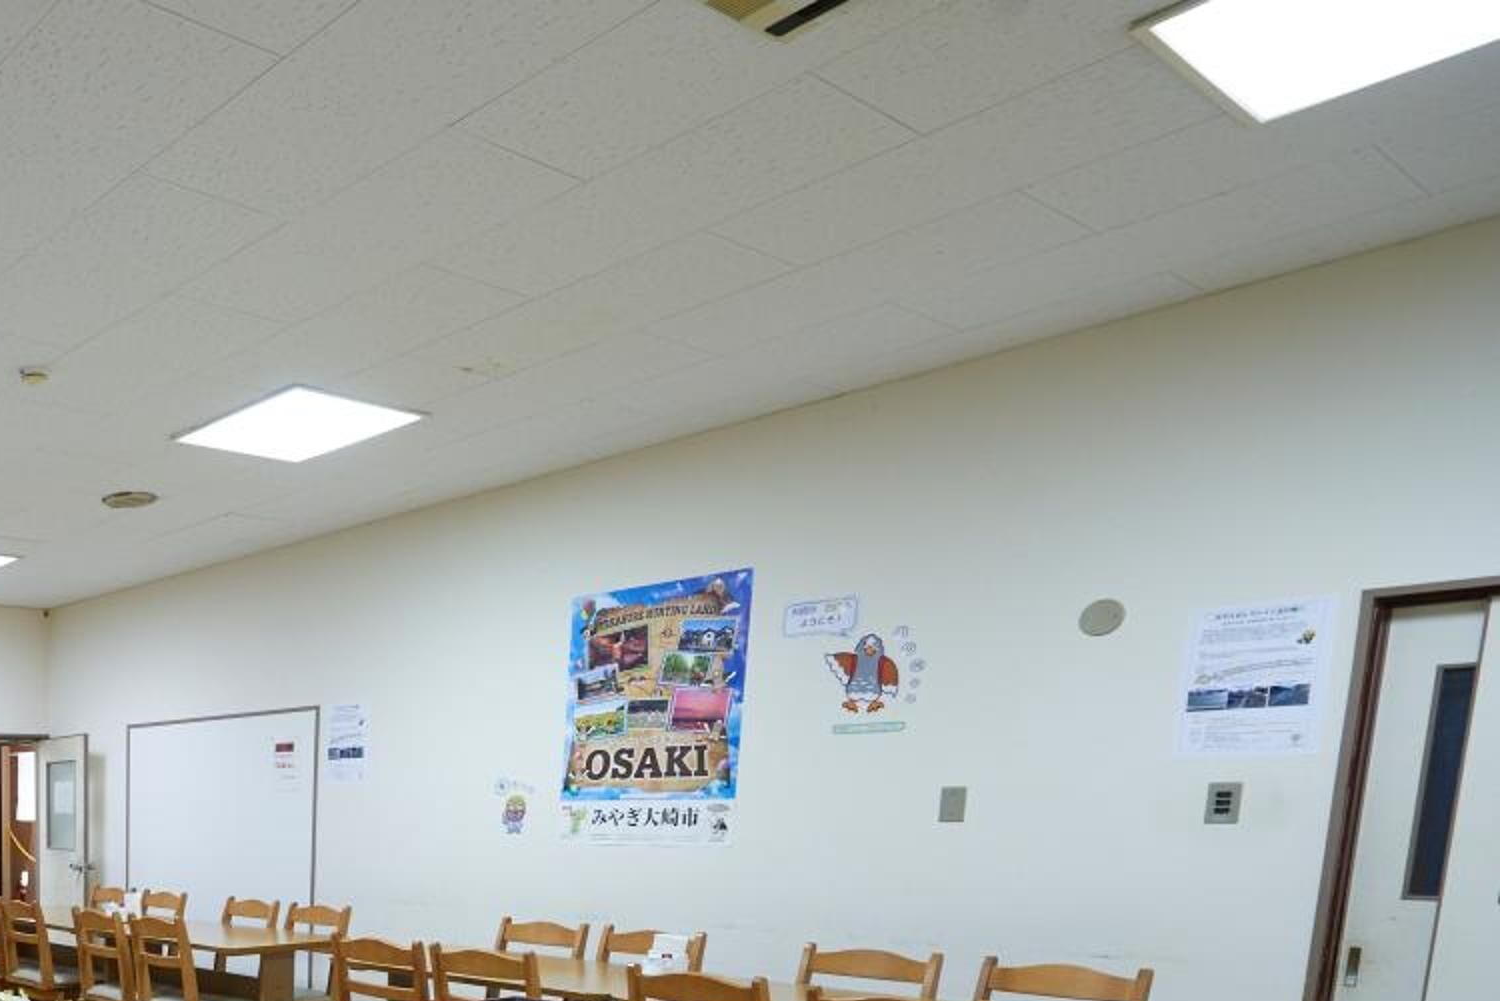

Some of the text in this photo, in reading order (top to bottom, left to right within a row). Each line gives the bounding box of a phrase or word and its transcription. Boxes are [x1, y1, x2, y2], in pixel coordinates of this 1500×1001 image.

[585, 743, 709, 780] OSAKI
[591, 806, 700, 828] みやぎ大崎市
